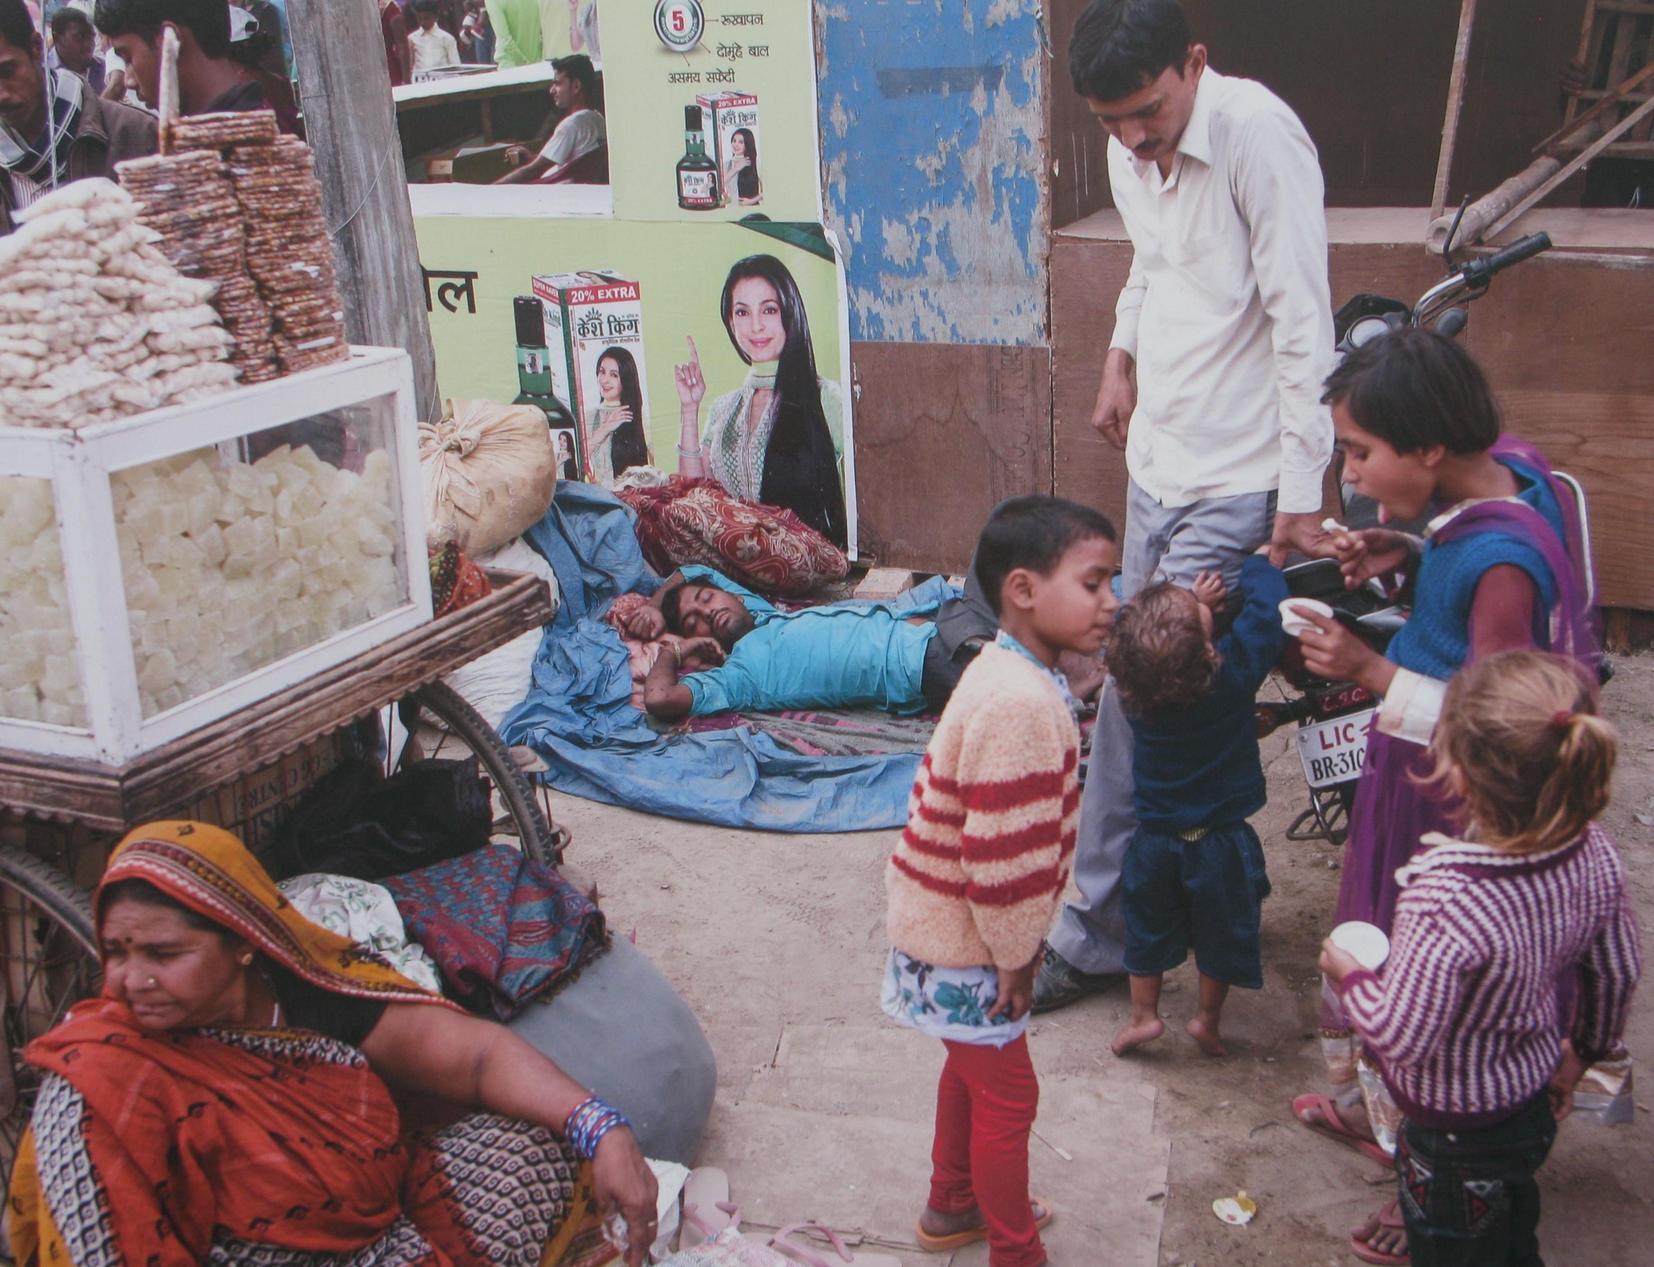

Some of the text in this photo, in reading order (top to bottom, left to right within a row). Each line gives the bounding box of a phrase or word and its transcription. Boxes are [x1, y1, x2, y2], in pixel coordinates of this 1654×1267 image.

[672, 10, 684, 31] 5
[748, 45, 769, 57] बाल
[667, 68, 735, 84] असमय सफेदी
[733, 97, 755, 105] EXTRA
[571, 286, 636, 303] 20% EXTRA
[577, 317, 604, 337] केश
[607, 314, 639, 335] किंग
[1318, 723, 1355, 750] LIC
